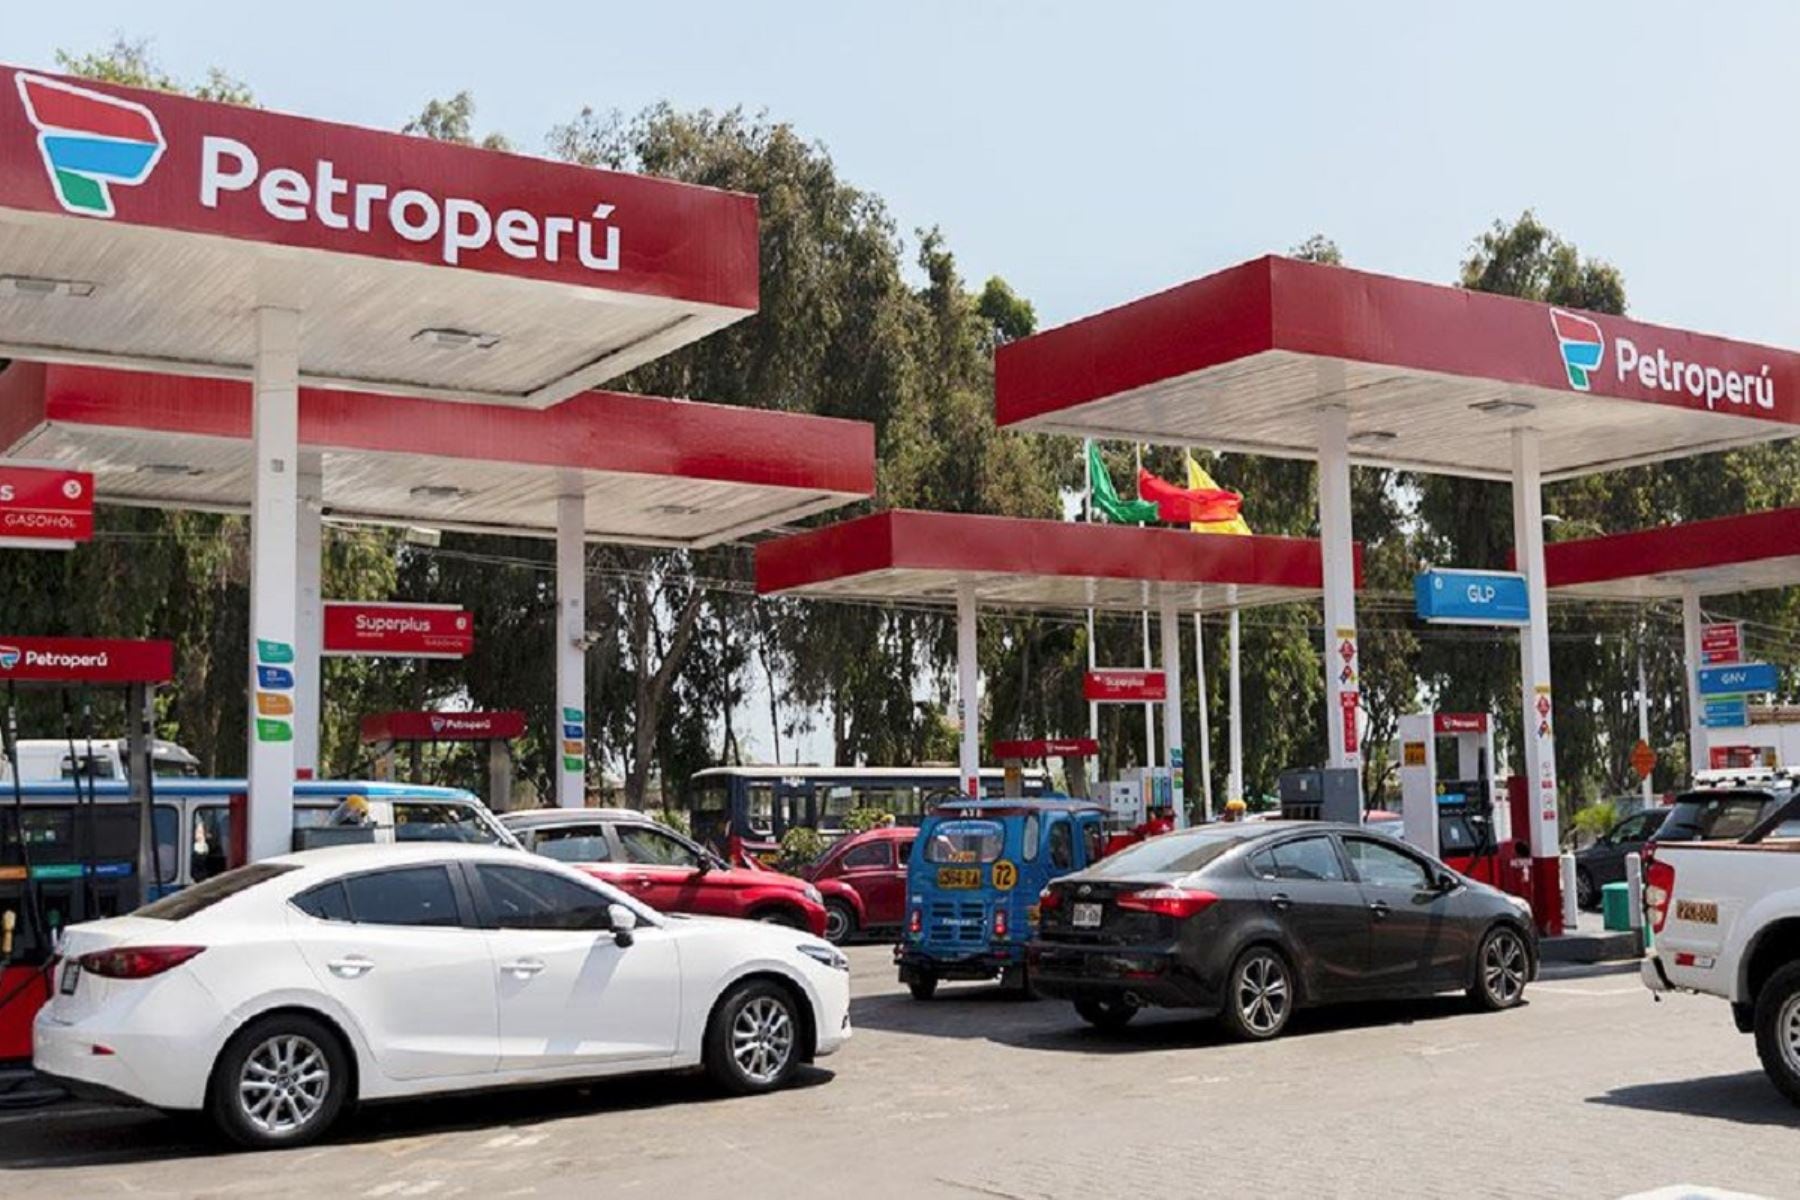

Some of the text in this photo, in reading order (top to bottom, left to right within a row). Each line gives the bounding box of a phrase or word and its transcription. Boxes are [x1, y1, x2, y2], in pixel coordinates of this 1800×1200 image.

[200, 135, 620, 271] Petroperú
[1615, 337, 1774, 409] Petroperú
[5, 513, 75, 528] GASOHOL
[1467, 584, 1495, 603] GLP
[356, 614, 431, 633] Superplus
[26, 651, 108, 668] Petroperú
[1720, 672, 1746, 685] GNV
[995, 864, 1012, 885] 72
